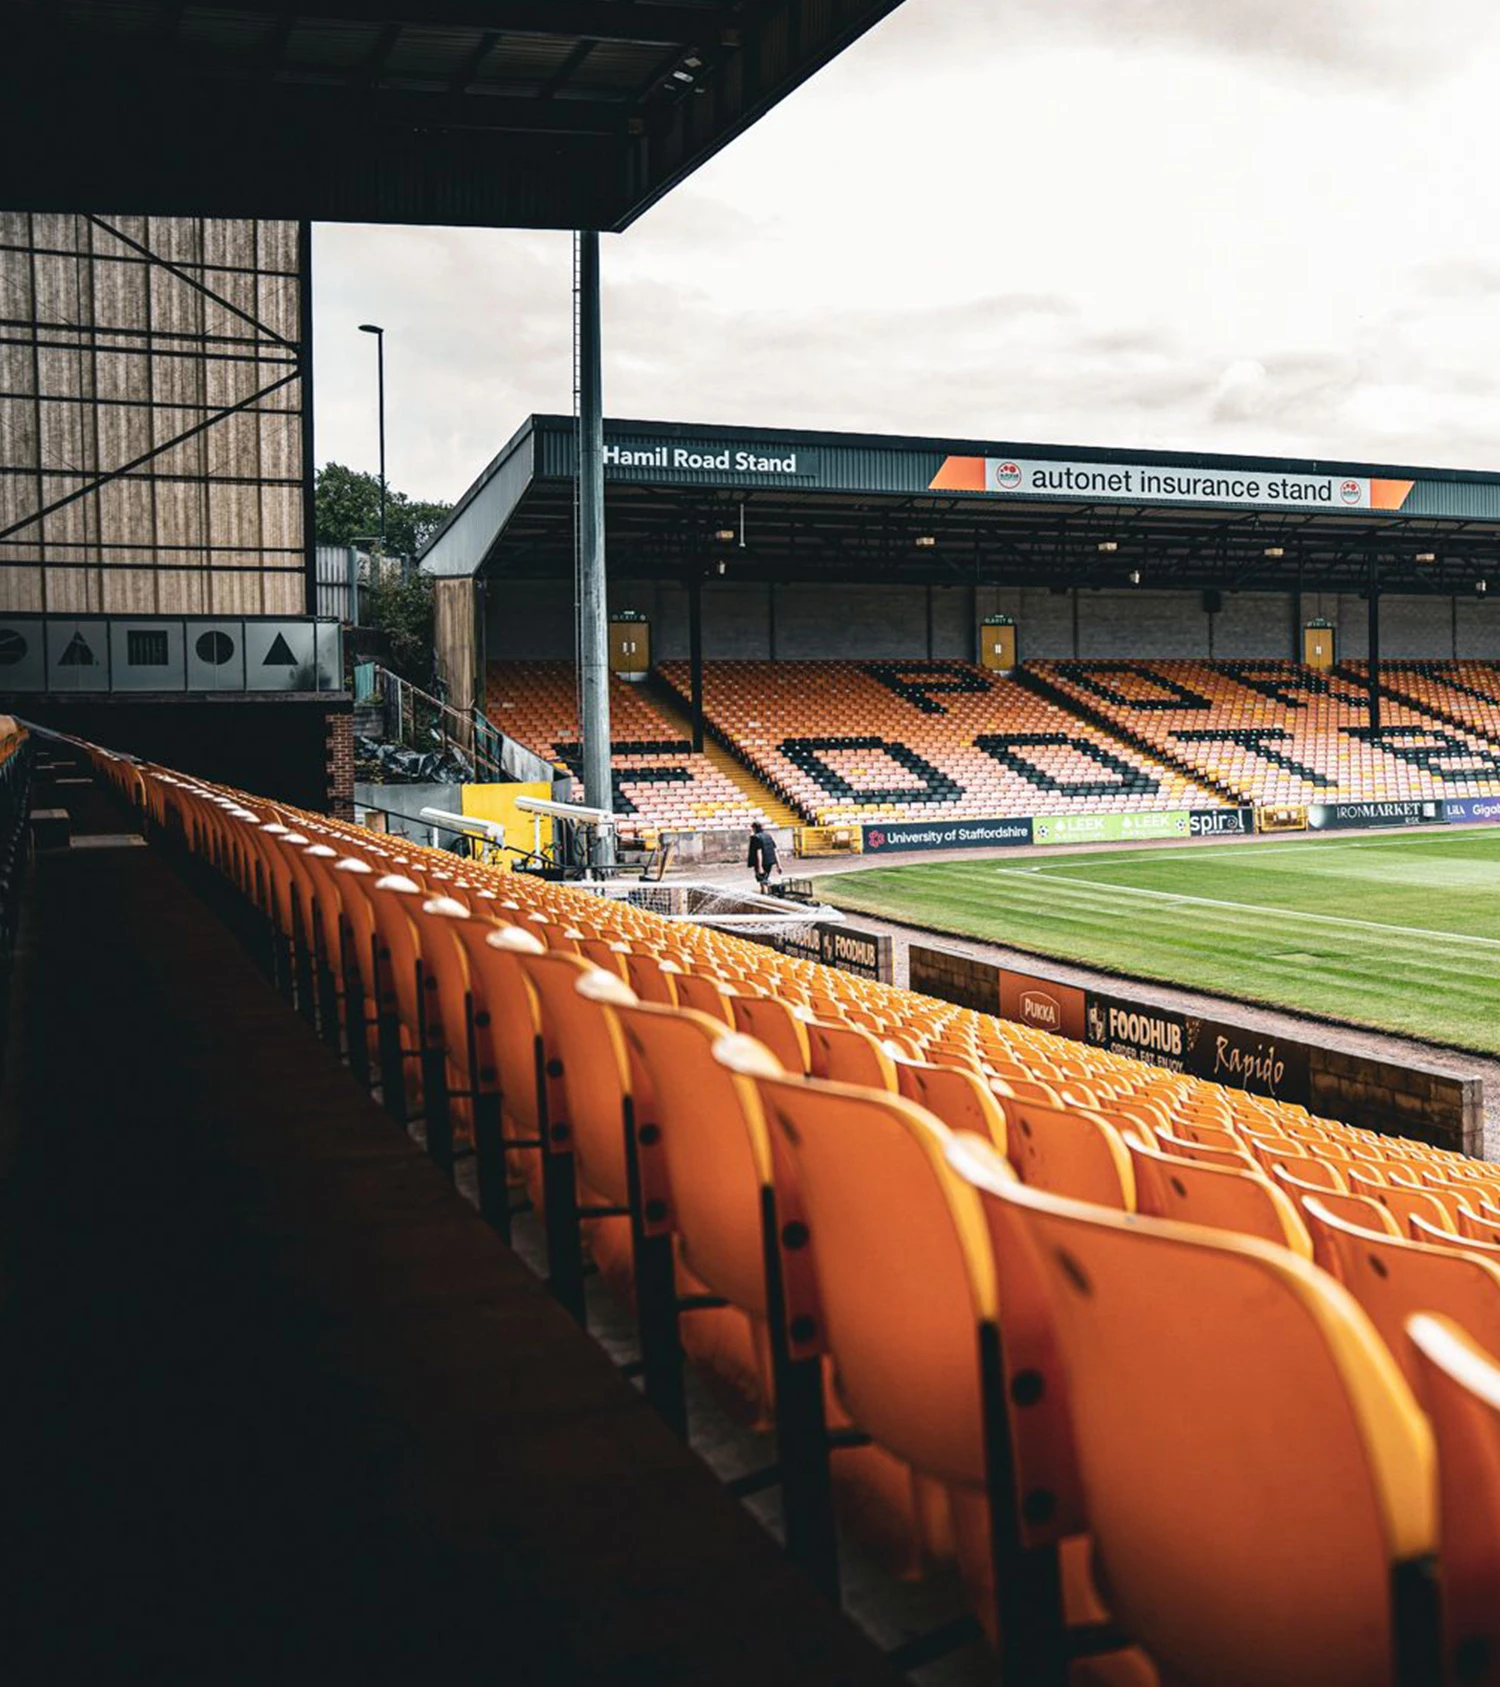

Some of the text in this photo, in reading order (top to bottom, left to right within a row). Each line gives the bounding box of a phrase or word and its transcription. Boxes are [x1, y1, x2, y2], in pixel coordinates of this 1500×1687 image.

[602, 446, 796, 472] Hamil Road Stand
[1032, 465, 1331, 502] autonet insurance stand
[1068, 815, 1171, 831] LEEK LEEK
[1336, 802, 1421, 819] IRONMARKET
[887, 826, 1028, 845] University of Staffordshire
[835, 934, 876, 967] FOODHUB
[1024, 998, 1057, 1026] PUKKA
[1109, 1007, 1182, 1055] FOODHUB
[1214, 1034, 1285, 1096] Rapido
